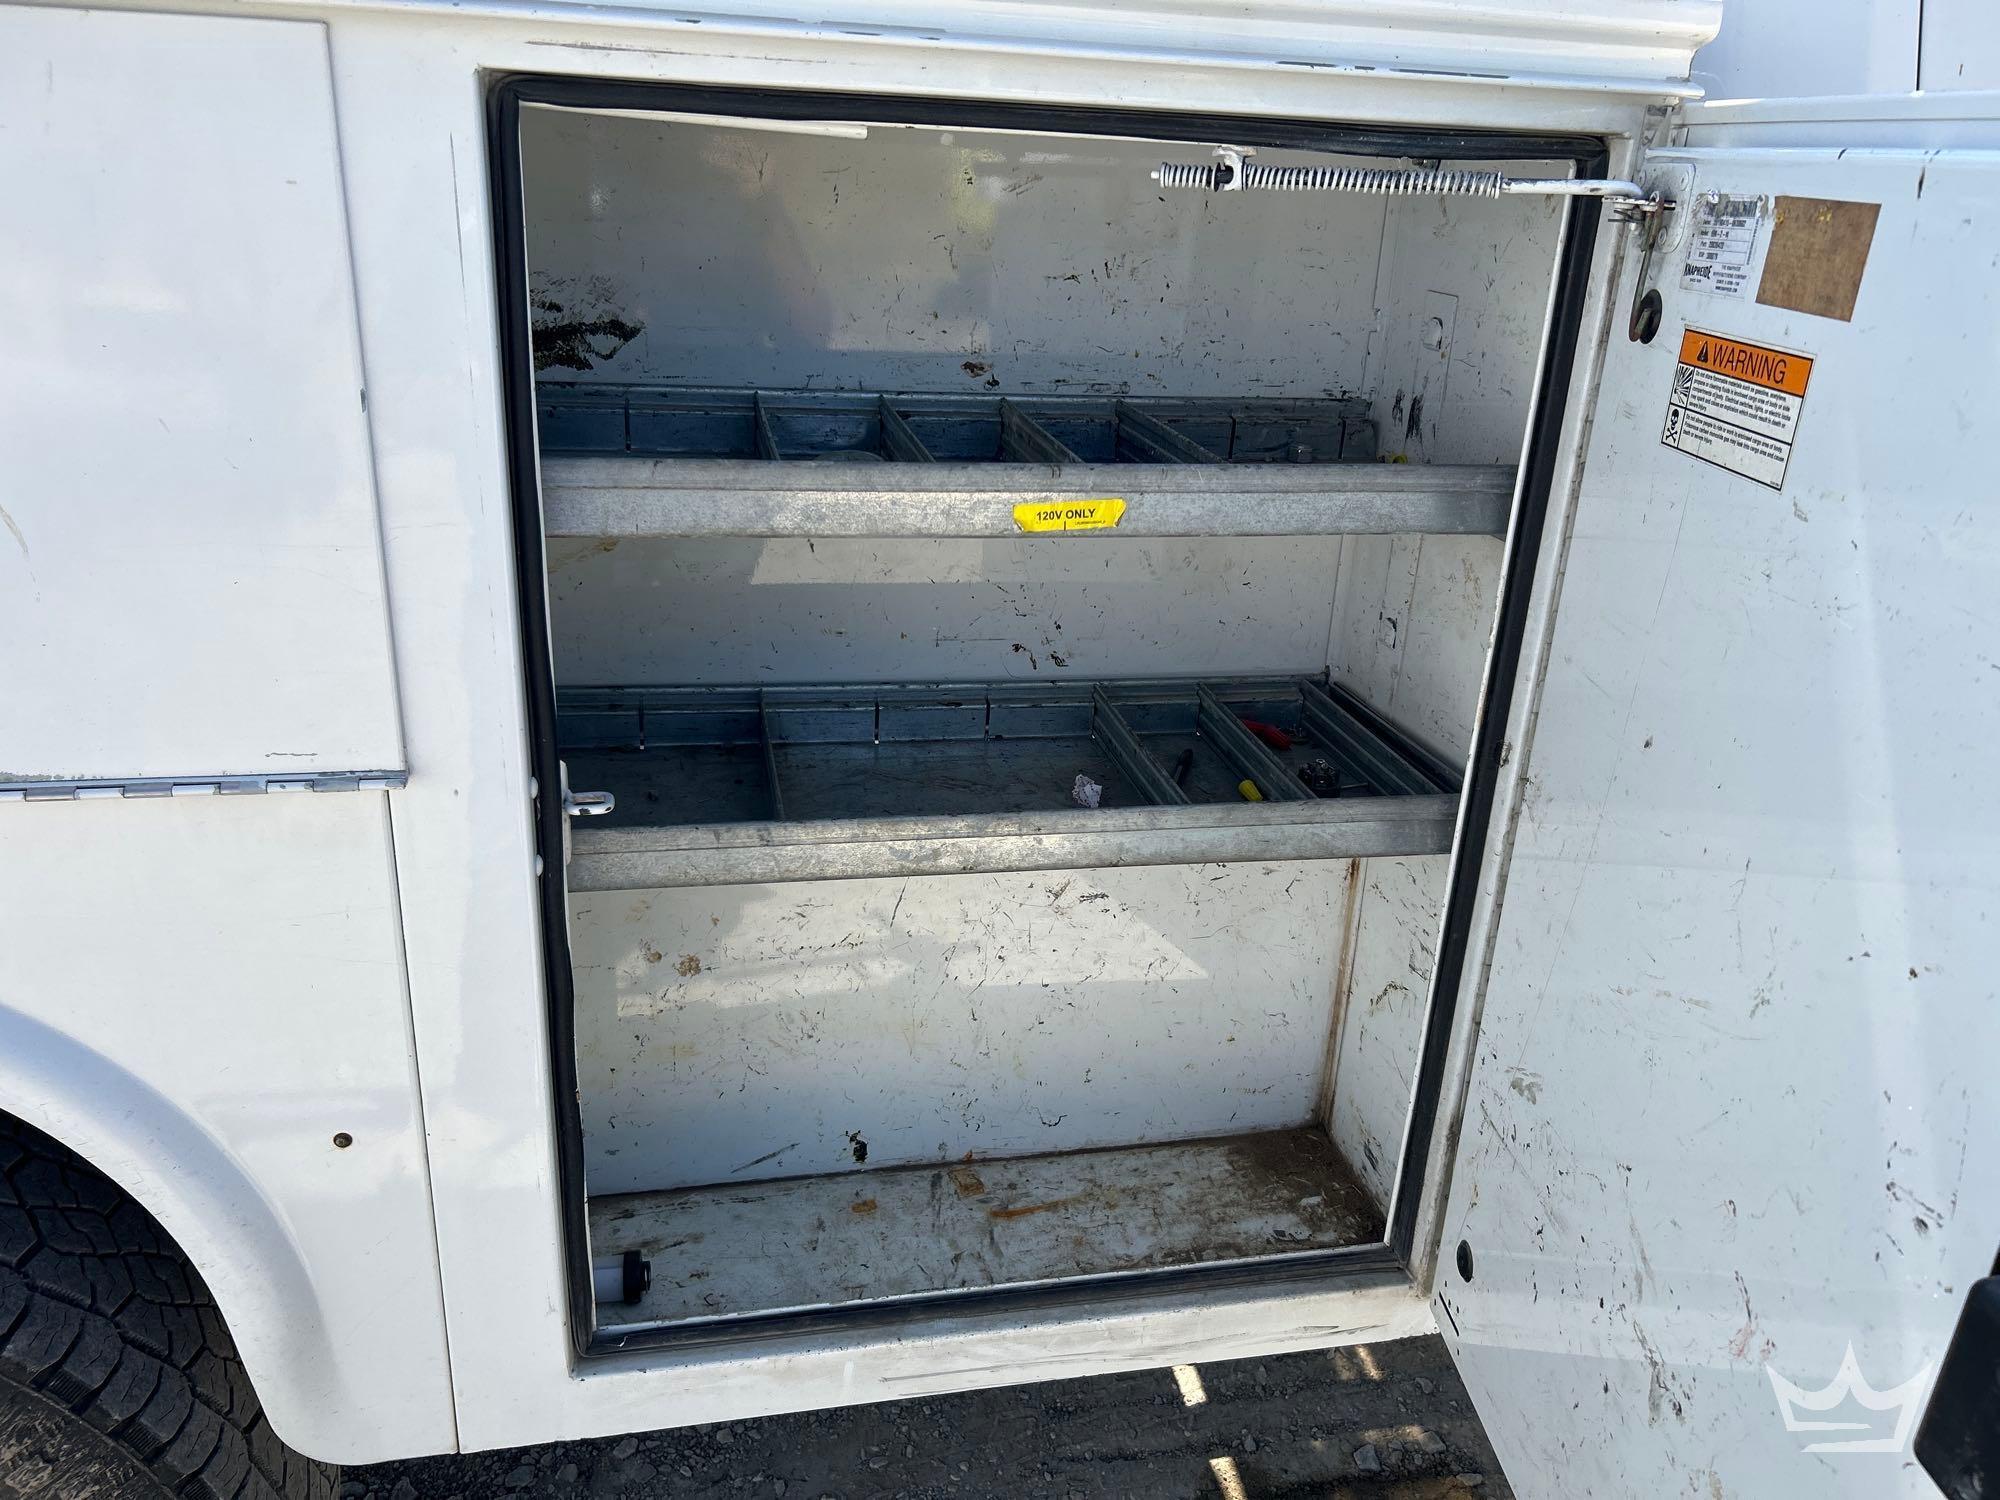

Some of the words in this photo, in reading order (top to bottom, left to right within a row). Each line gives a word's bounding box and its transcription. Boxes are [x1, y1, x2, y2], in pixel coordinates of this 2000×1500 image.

[1683, 262, 1712, 280] KNAPHEIDE
[1712, 343, 1787, 384] WARNING
[1036, 510, 1062, 521] 120V
[1066, 508, 1096, 520] ONLY
